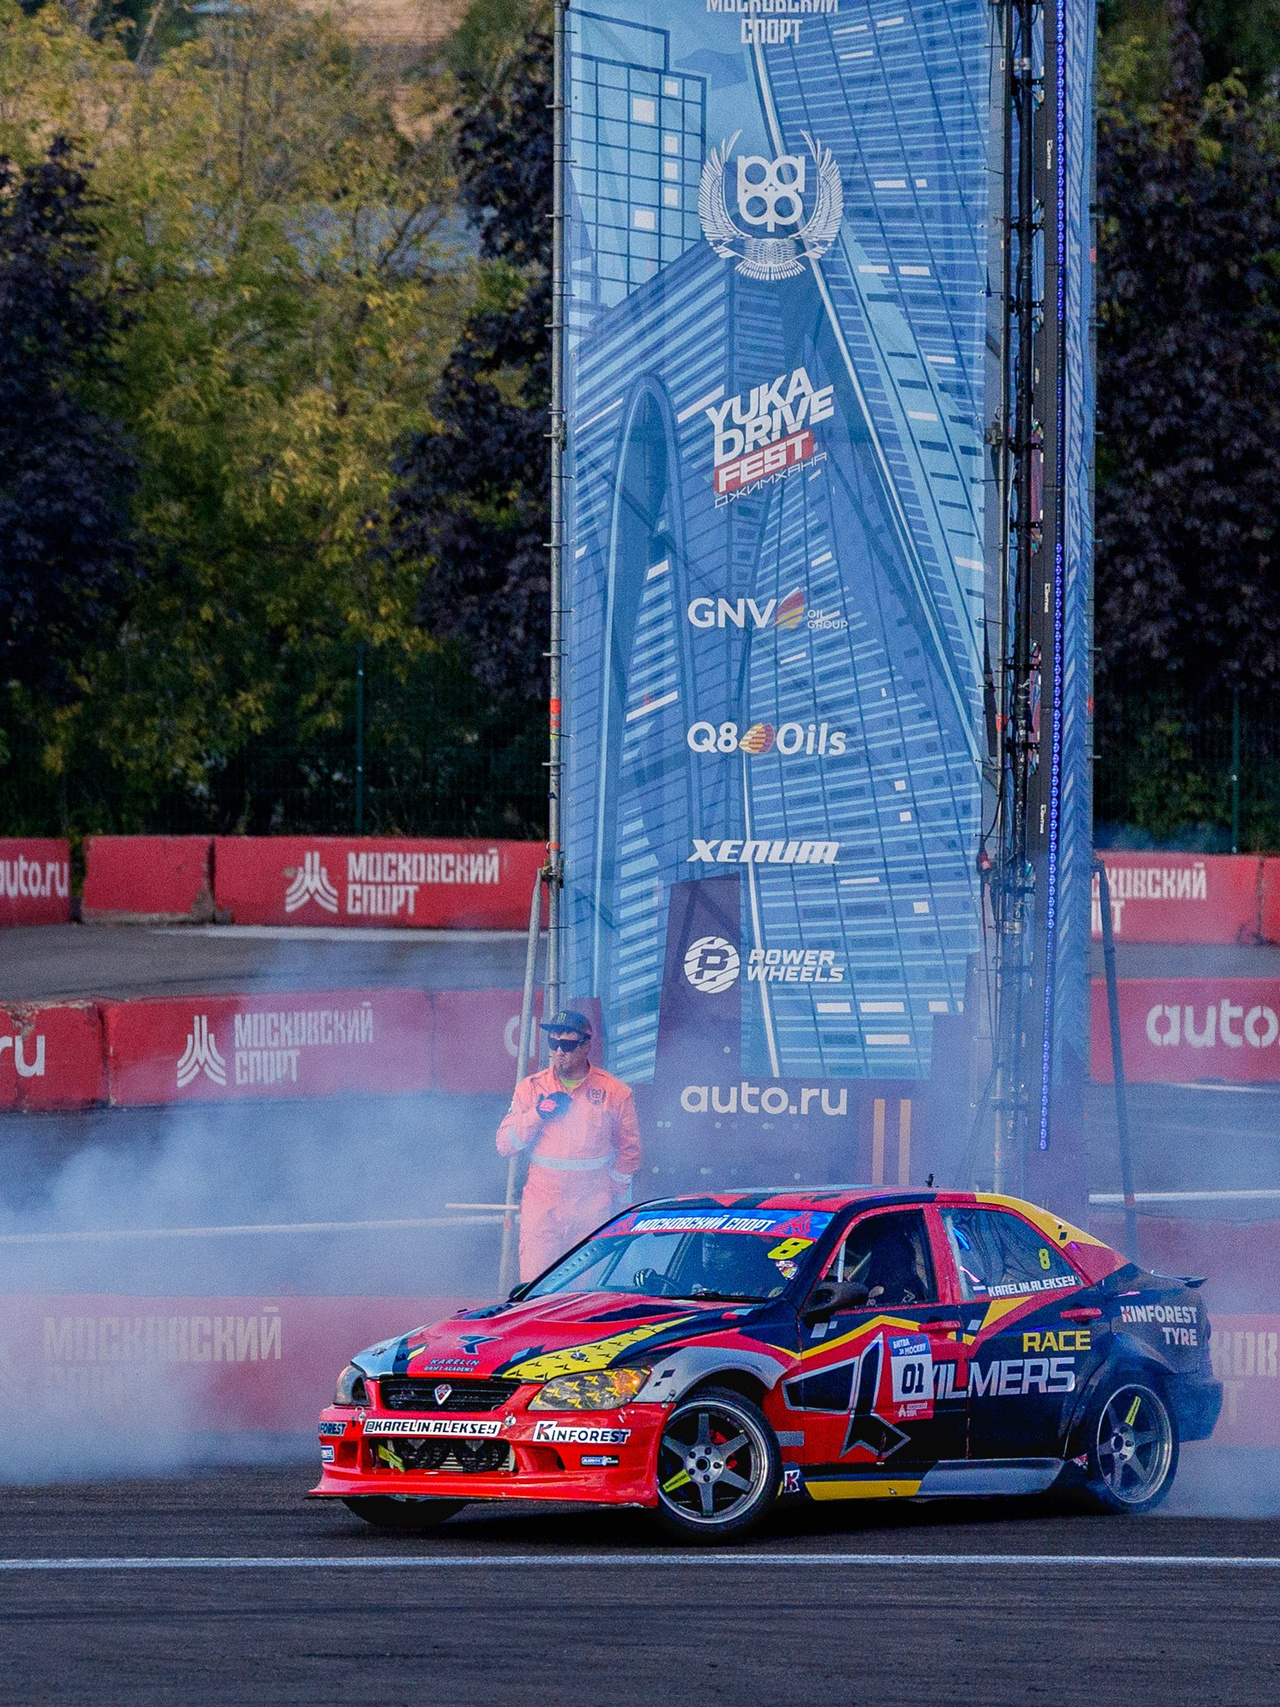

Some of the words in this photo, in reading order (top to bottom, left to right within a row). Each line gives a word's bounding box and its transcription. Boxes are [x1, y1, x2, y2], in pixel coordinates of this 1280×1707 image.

[741, 19, 804, 44] СПОРТ
[705, 366, 814, 436] YUKA
[714, 384, 835, 467] DRIVE
[718, 431, 810, 493] FEST
[687, 597, 778, 629] GNV
[807, 609, 825, 619] OIL
[807, 620, 848, 630] GROUP
[687, 721, 739, 753] Q8
[776, 722, 847, 755] Oils
[686, 839, 841, 865] XENUM
[347, 848, 500, 885] МОСКОВСКИЙ
[1091, 862, 1208, 900] КОВСКИЙ
[347, 883, 420, 916] СПОРТ
[748, 949, 836, 966] POWER
[747, 966, 845, 983] WHEELS
[234, 1001, 375, 1048] МОСКОВСКИЙ
[1146, 998, 1280, 1048] auto
[234, 1047, 300, 1086] СПОРТ
[680, 1081, 848, 1116] auto.ru
[630, 1214, 730, 1232] МОСКОВСКИЙ
[722, 1218, 777, 1232] СПОРТ
[767, 1237, 814, 1260] 8
[1038, 1248, 1051, 1269] 8
[1120, 1305, 1198, 1325] KINFOREST
[1023, 1331, 1092, 1352] RACE
[1163, 1327, 1198, 1347] TYRE
[430, 1358, 480, 1366] KARELIN
[901, 1362, 925, 1394] 01
[320, 1422, 347, 1435] FOREST
[536, 1423, 630, 1442] KINFOREST
